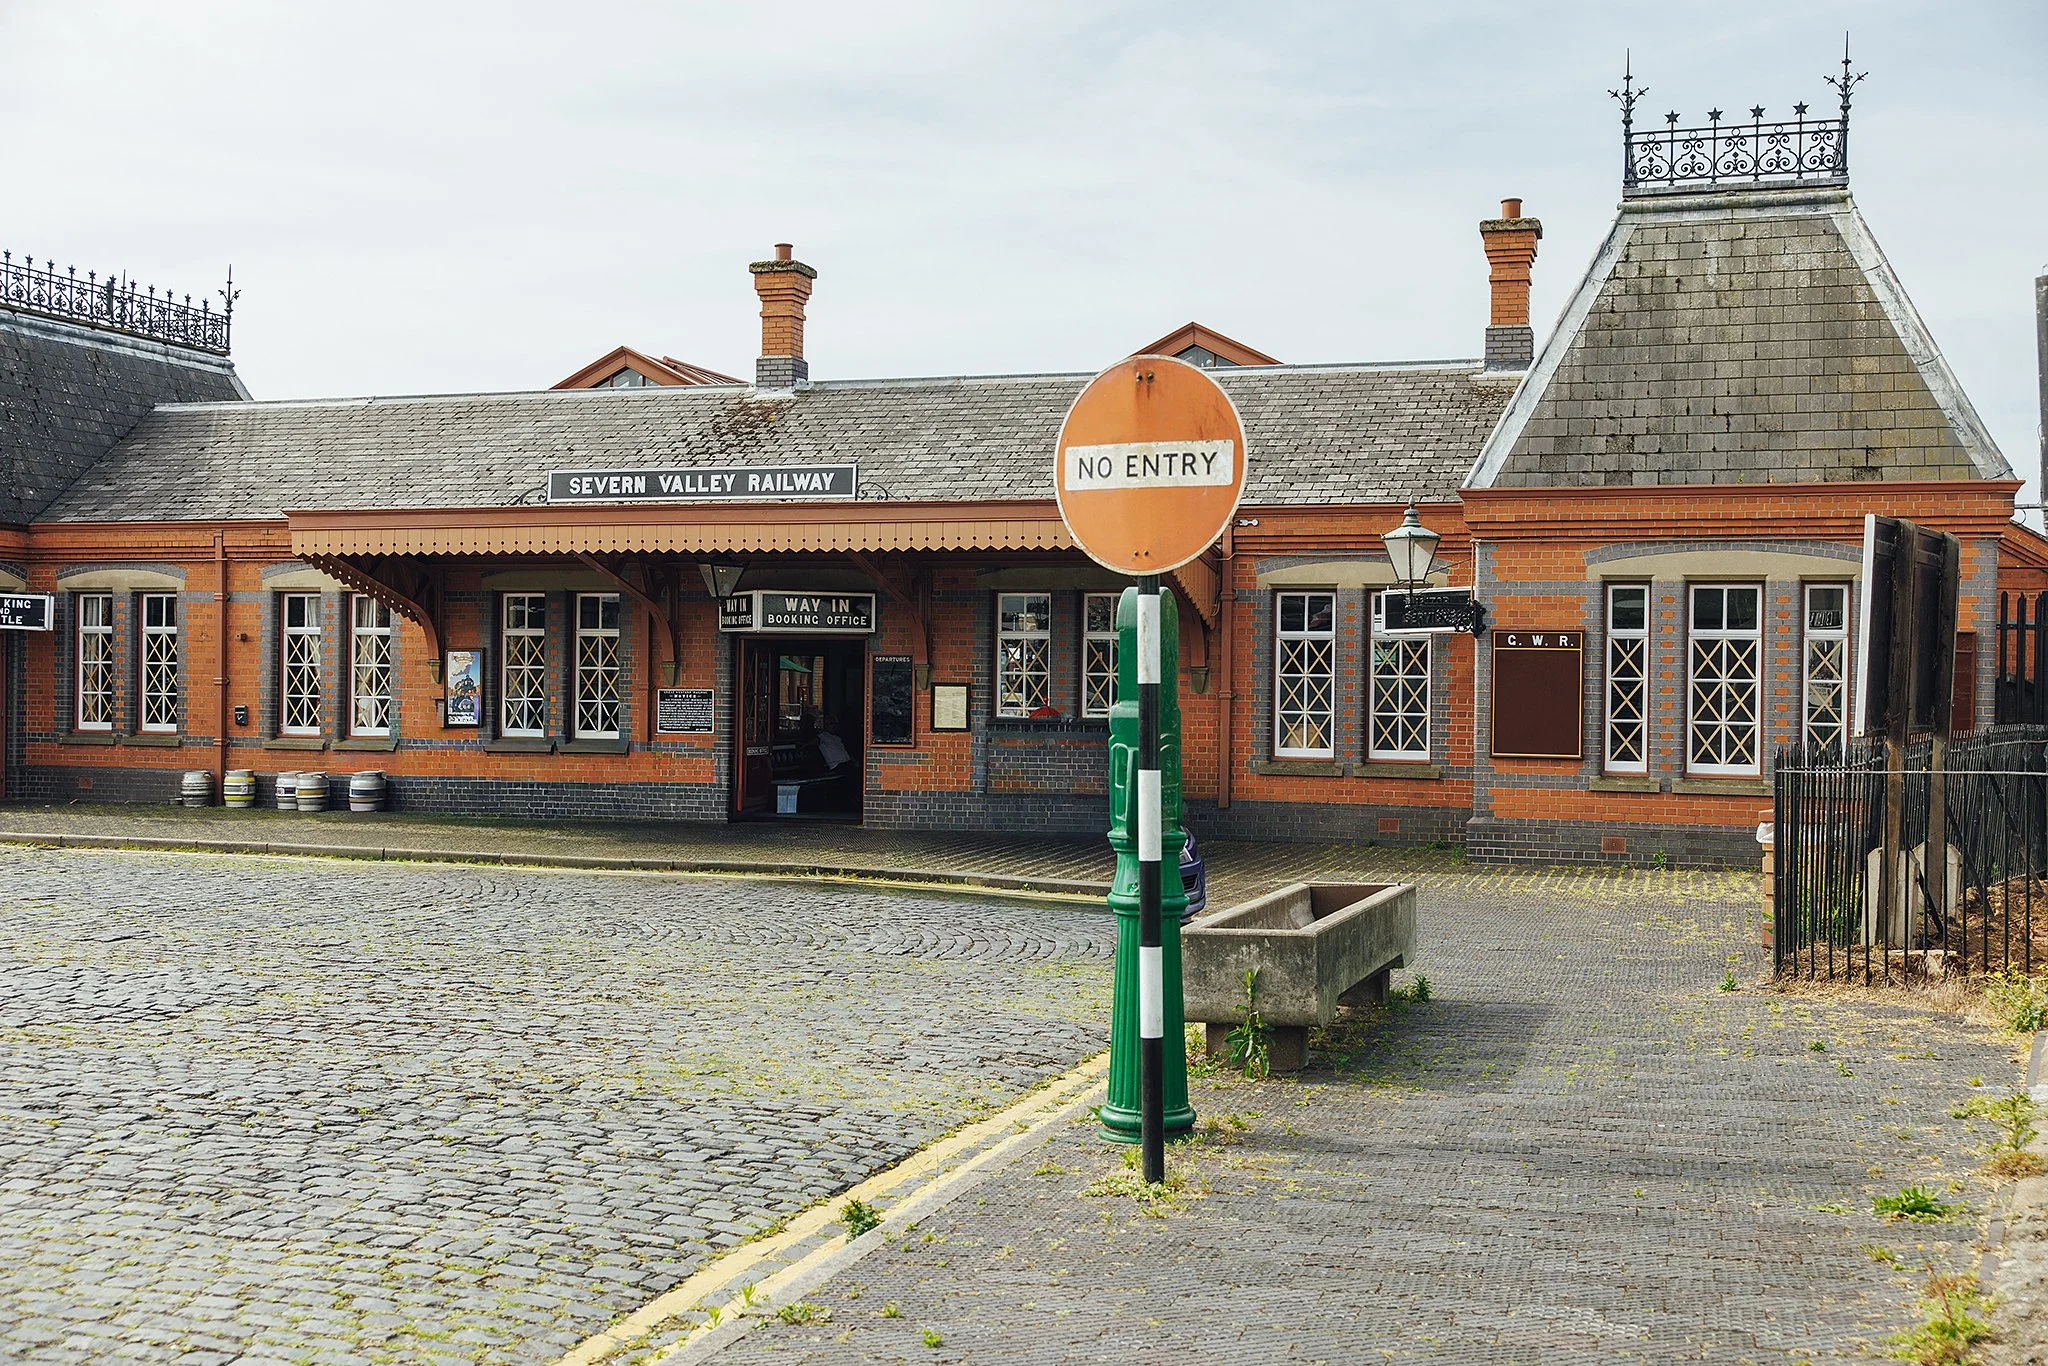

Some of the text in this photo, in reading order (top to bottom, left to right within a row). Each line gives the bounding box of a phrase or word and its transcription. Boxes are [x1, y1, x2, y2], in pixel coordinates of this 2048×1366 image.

[1078, 452, 1218, 480] NO ENTRY
[569, 472, 835, 495] SEVERN VALLEY RAILWAY
[4, 599, 31, 608] KING
[785, 598, 849, 613] WAY IN
[768, 613, 867, 626] BOOKING OFFICE
